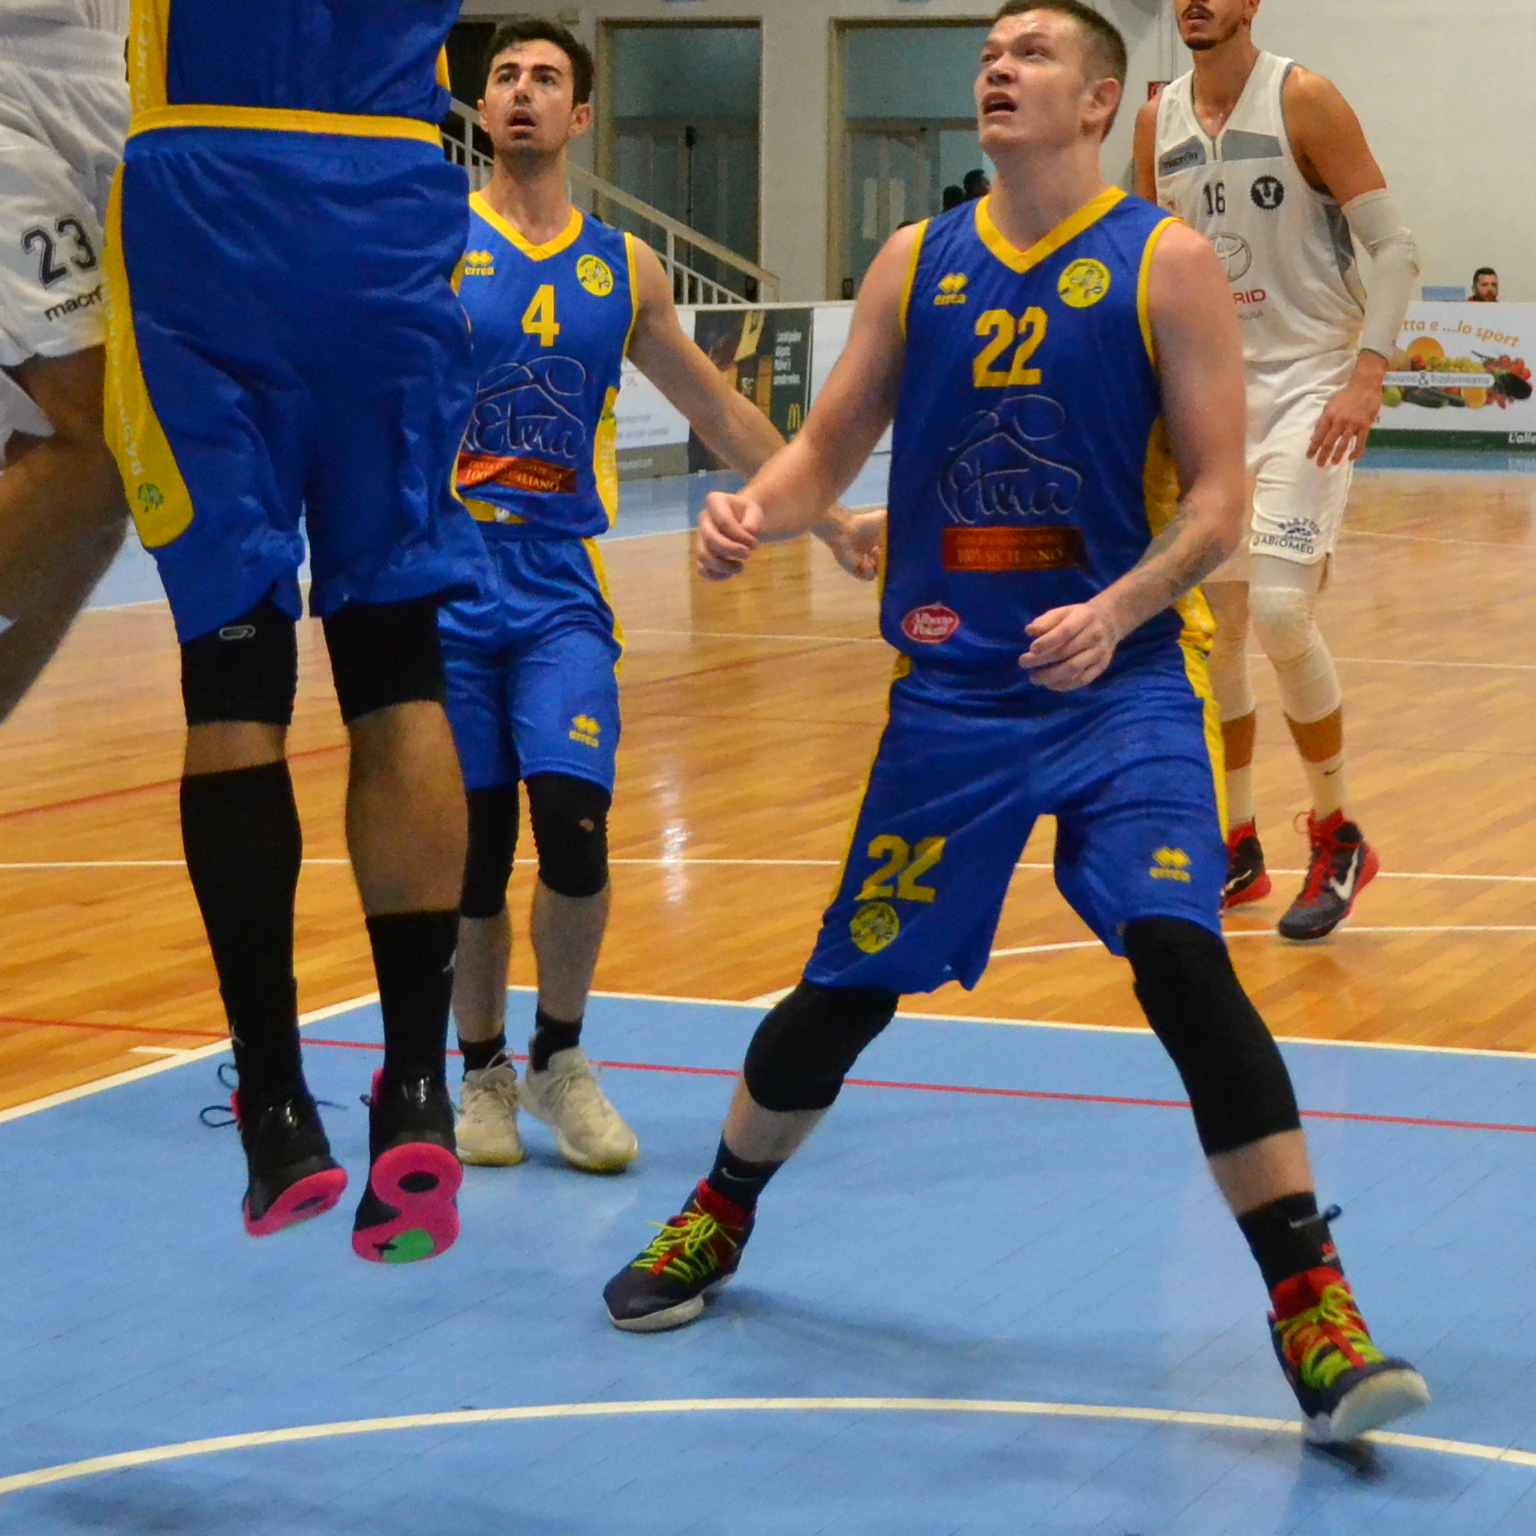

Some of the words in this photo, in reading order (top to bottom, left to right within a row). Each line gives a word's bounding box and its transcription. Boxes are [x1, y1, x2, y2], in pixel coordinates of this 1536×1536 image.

[1202, 181, 1227, 215] 16
[21, 214, 99, 291] 23
[520, 283, 560, 347] 4
[972, 305, 1049, 388] 22
[1475, 325, 1520, 347] sport
[853, 833, 947, 903] 22
